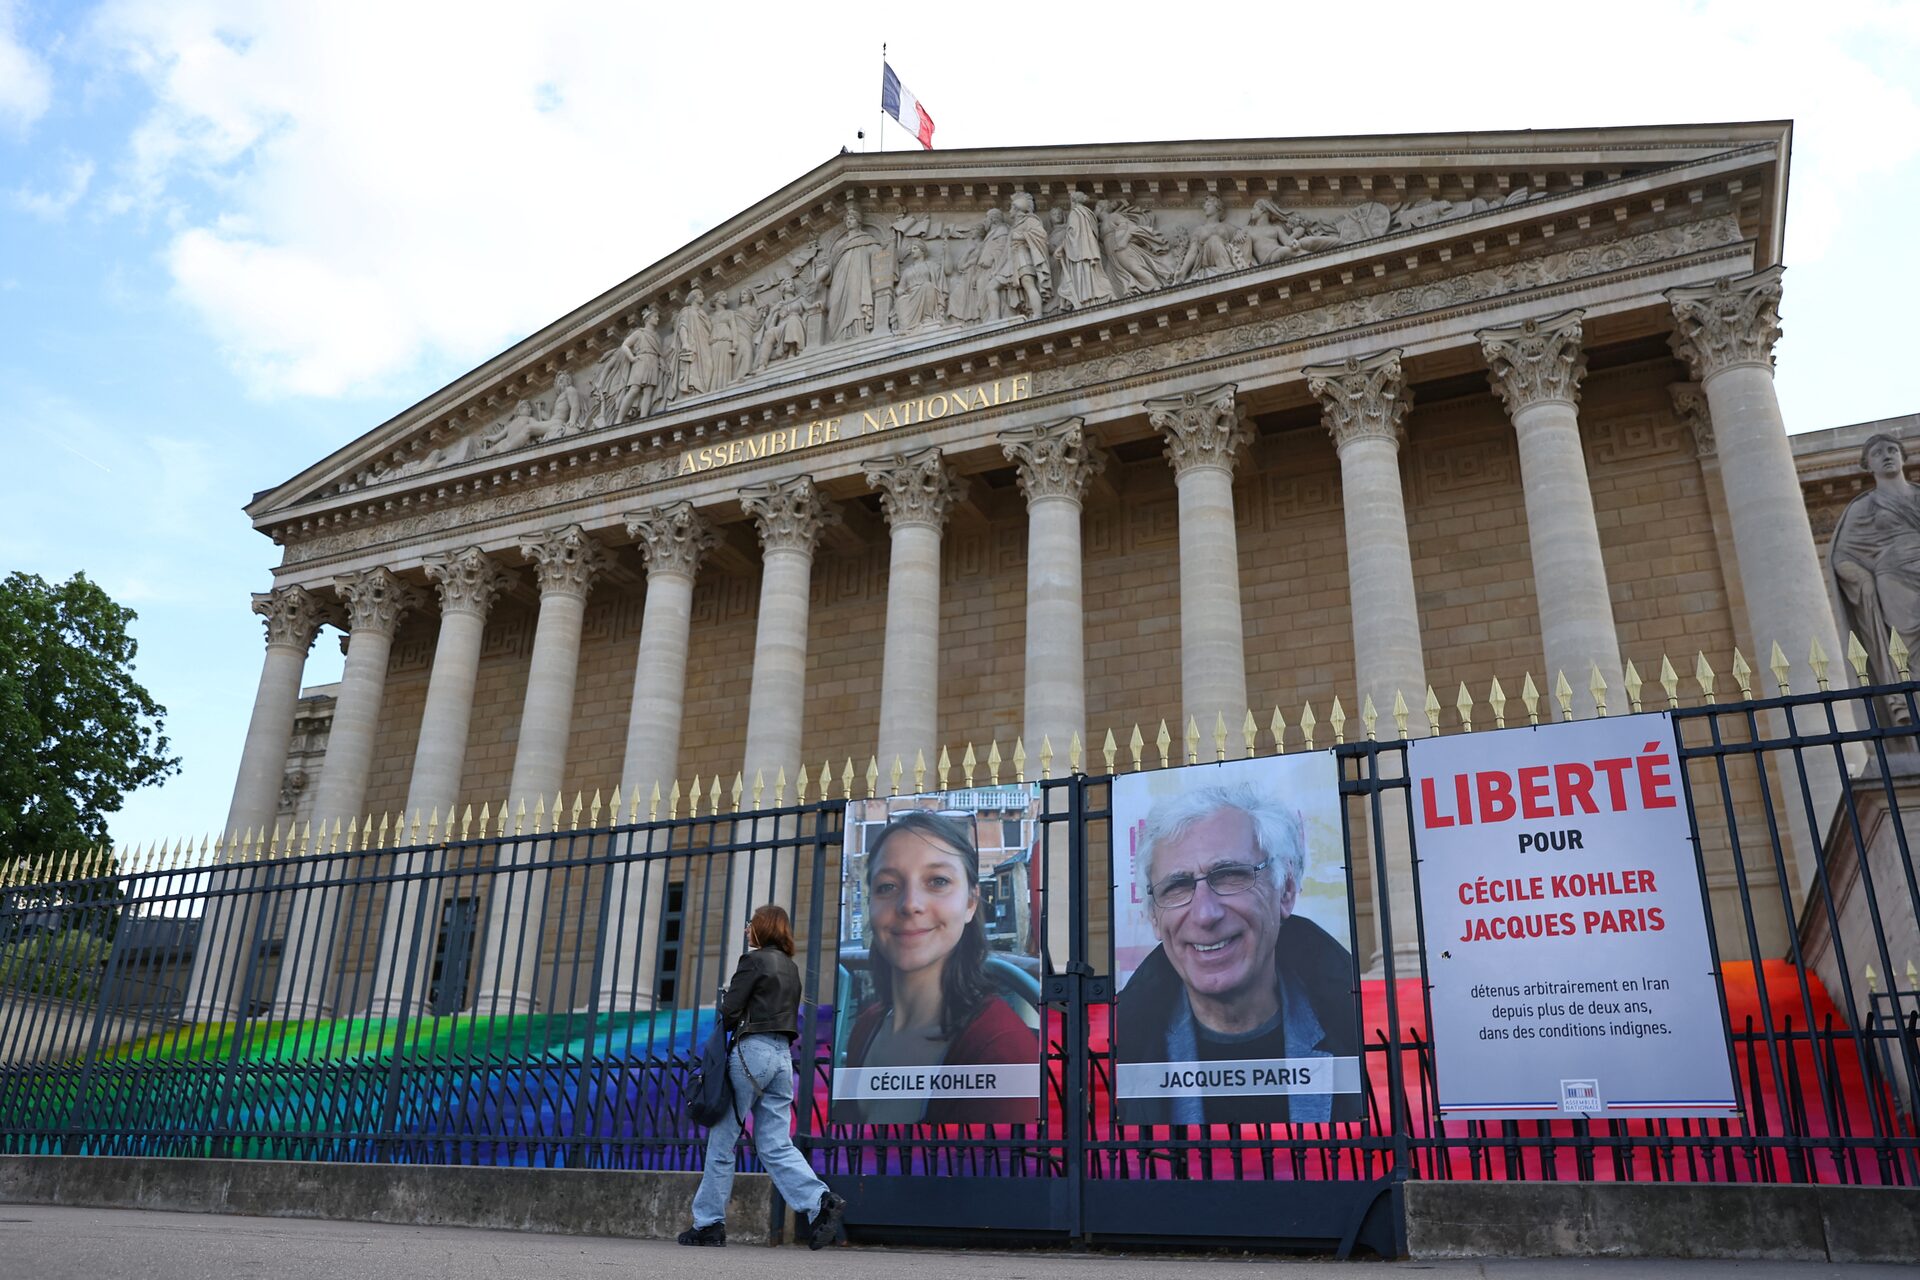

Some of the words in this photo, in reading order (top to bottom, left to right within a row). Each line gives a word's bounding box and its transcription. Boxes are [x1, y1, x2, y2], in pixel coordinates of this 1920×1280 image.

[679, 418, 842, 476] ASSEMBLÉE
[861, 375, 1030, 435] NATIONALE
[1421, 741, 1677, 829] LIBERTÉ
[1518, 829, 1584, 854] POUR
[1458, 875, 1545, 906] CÉCILE
[1551, 869, 1657, 899] KOHLER
[1459, 912, 1576, 942] JACQUES
[1583, 907, 1665, 935] PARIS
[1471, 983, 1520, 998] détenus
[1523, 979, 1619, 996] arbitrairement
[1622, 980, 1638, 992] en
[1642, 976, 1670, 991] Iran
[1492, 1003, 1534, 1021] depuis
[1537, 1002, 1565, 1020] plus
[1568, 1001, 1584, 1016] de
[1588, 1000, 1621, 1015] deux
[1624, 1001, 1652, 1015] ans,
[1479, 1026, 1510, 1041] dans
[1513, 1025, 1535, 1039] des
[1539, 1022, 1606, 1038] conditions
[1609, 1020, 1672, 1039] indignes.
[870, 1072, 925, 1091] CÉCILE
[930, 1073, 997, 1090] KOHLER
[1160, 1069, 1246, 1088] JACQUES
[1252, 1067, 1311, 1087] PARIS
